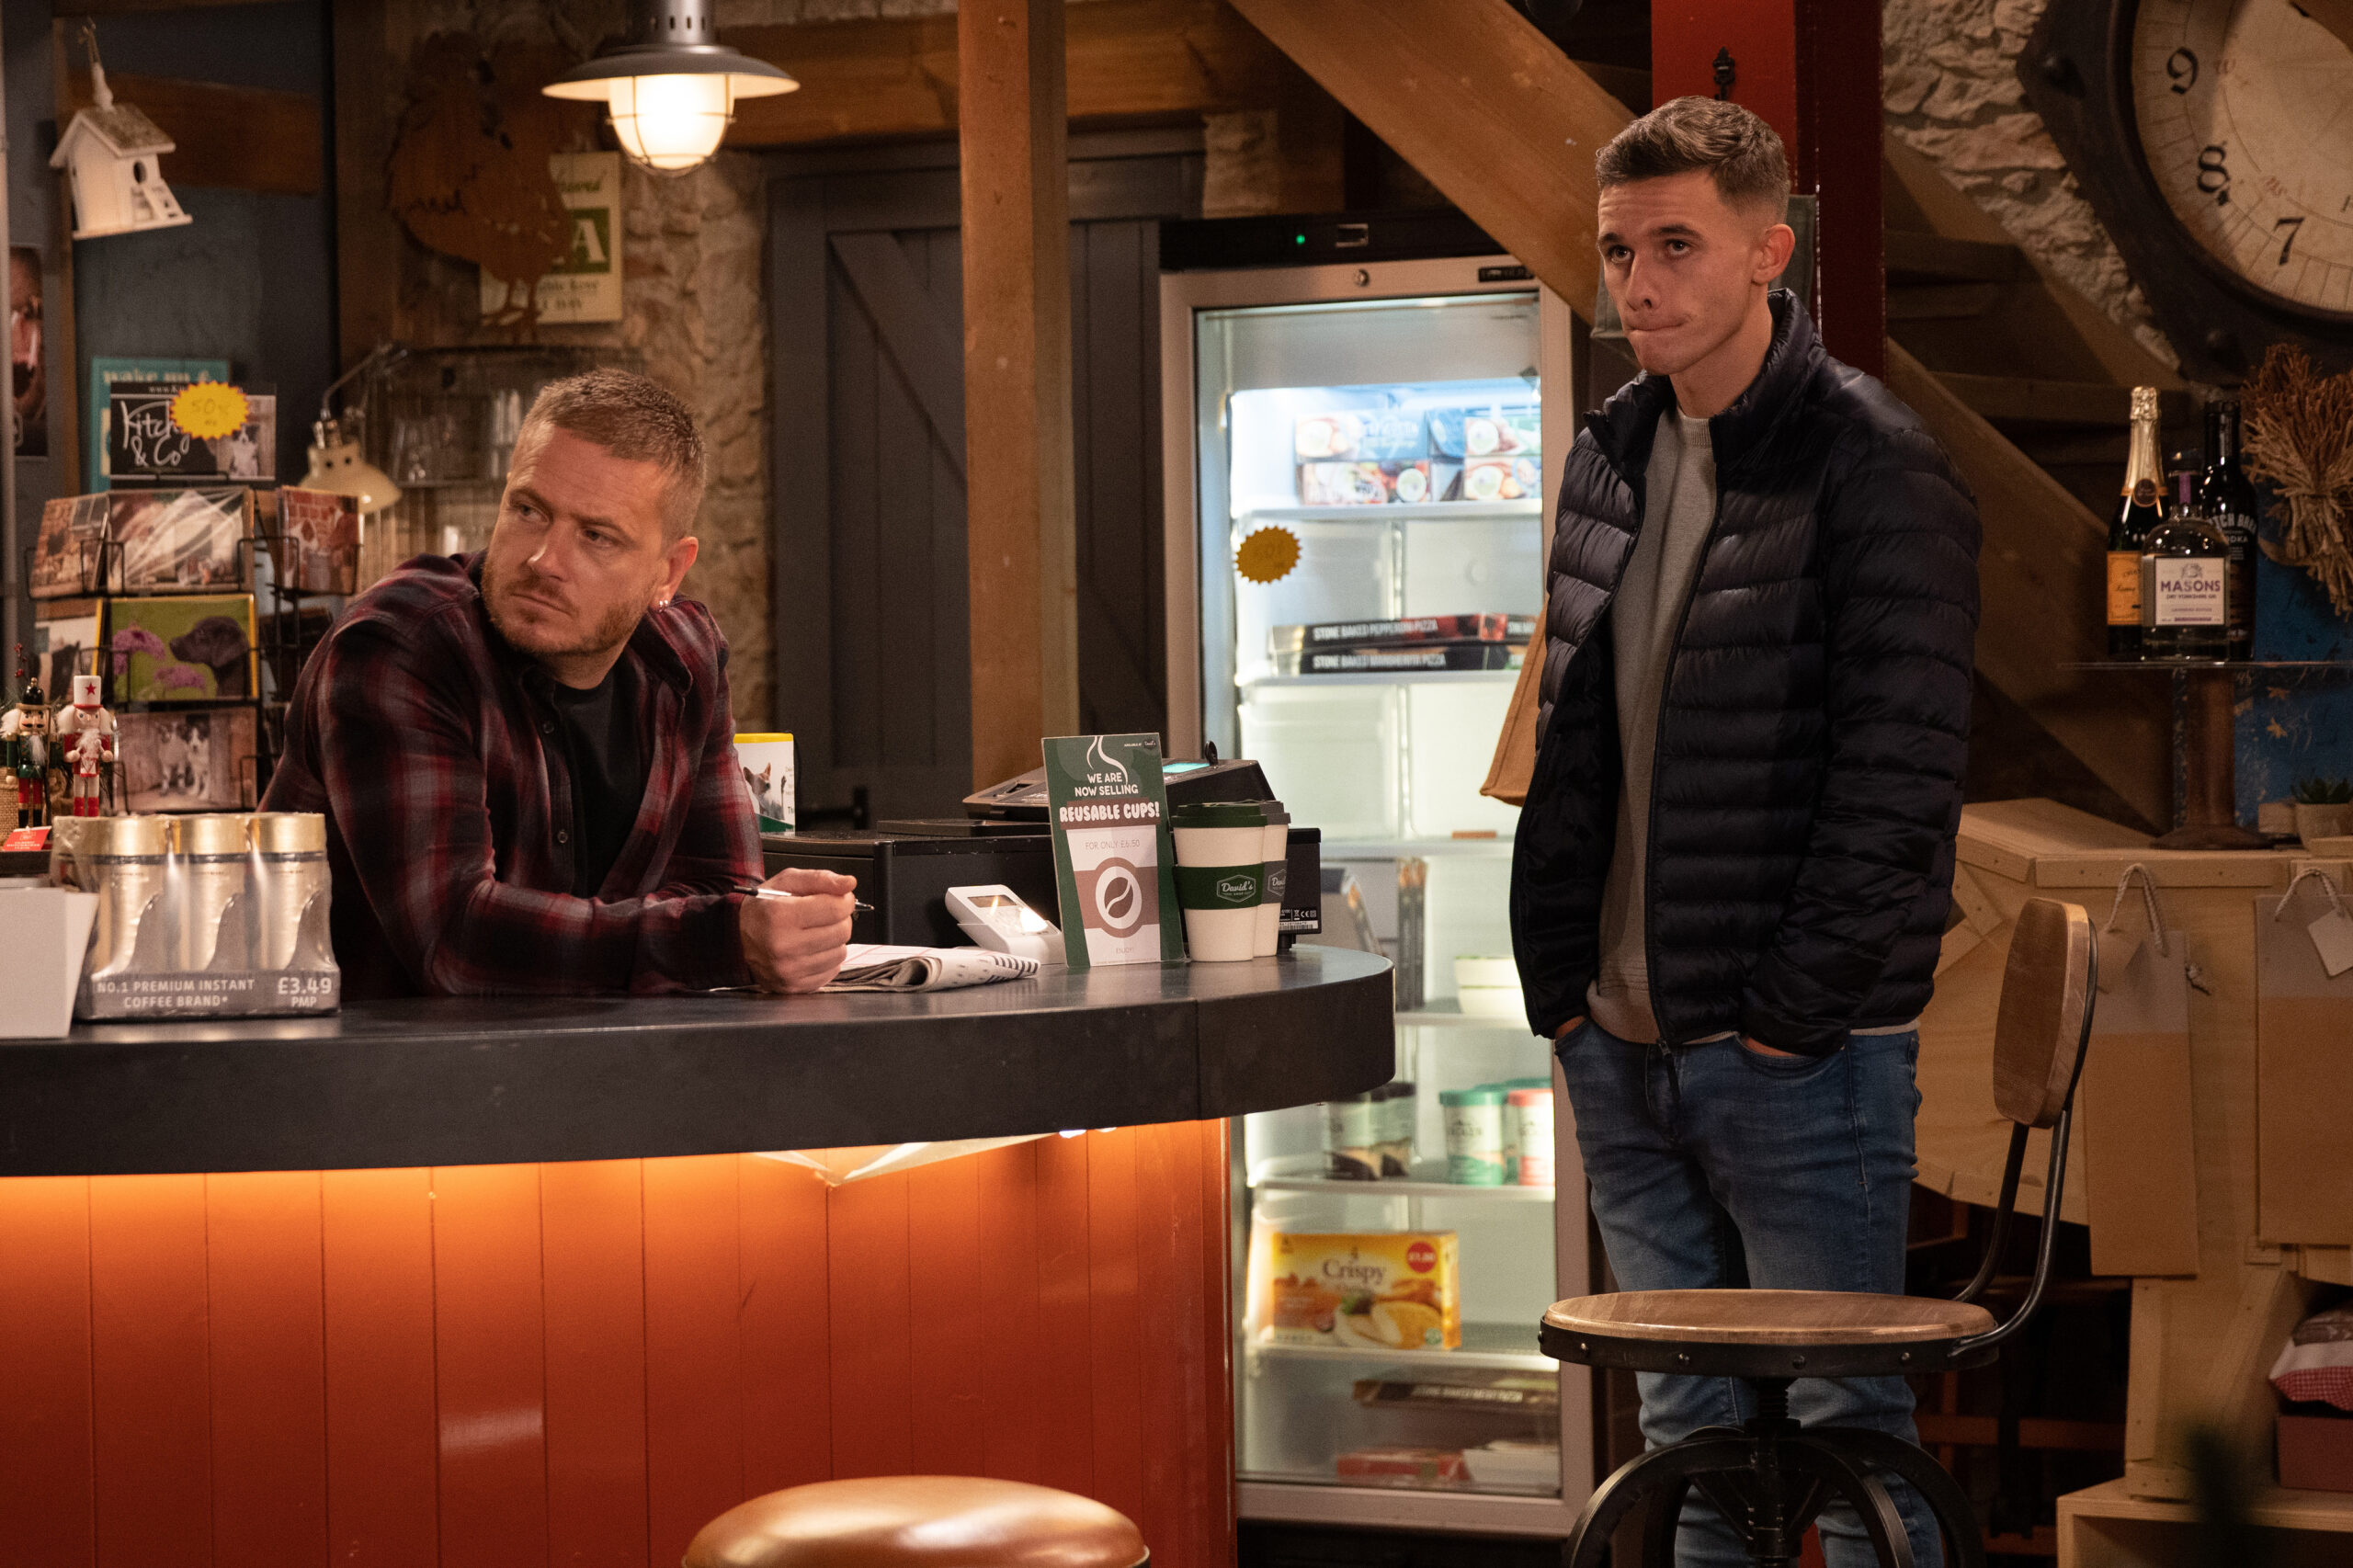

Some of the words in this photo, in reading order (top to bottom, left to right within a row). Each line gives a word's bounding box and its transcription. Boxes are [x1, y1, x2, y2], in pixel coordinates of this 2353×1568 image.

[2166, 47, 2199, 95] 9
[2197, 145, 2231, 194] 8
[2274, 217, 2304, 266] 7
[131, 436, 150, 468] &
[154, 437, 181, 467] Co
[2160, 580, 2221, 592] MASONS
[1087, 773, 1102, 783] WE
[1105, 772, 1122, 783] ARE
[1074, 787, 1097, 797] NOW
[1099, 784, 1139, 796] SELLING
[1060, 804, 1120, 823] REUSABLE
[1123, 801, 1160, 819] CUPS!
[1085, 842, 1098, 850] FOR
[1100, 841, 1119, 849] ONLY
[1221, 881, 1254, 892] David's
[97, 981, 128, 994] NO.1
[133, 980, 195, 992] PREMIUM
[199, 979, 255, 991] INSTANT
[278, 976, 332, 995] £3.49
[124, 995, 172, 1008] COFFEE
[290, 995, 317, 1007] PMP
[1323, 1259, 1384, 1285] Crispy
